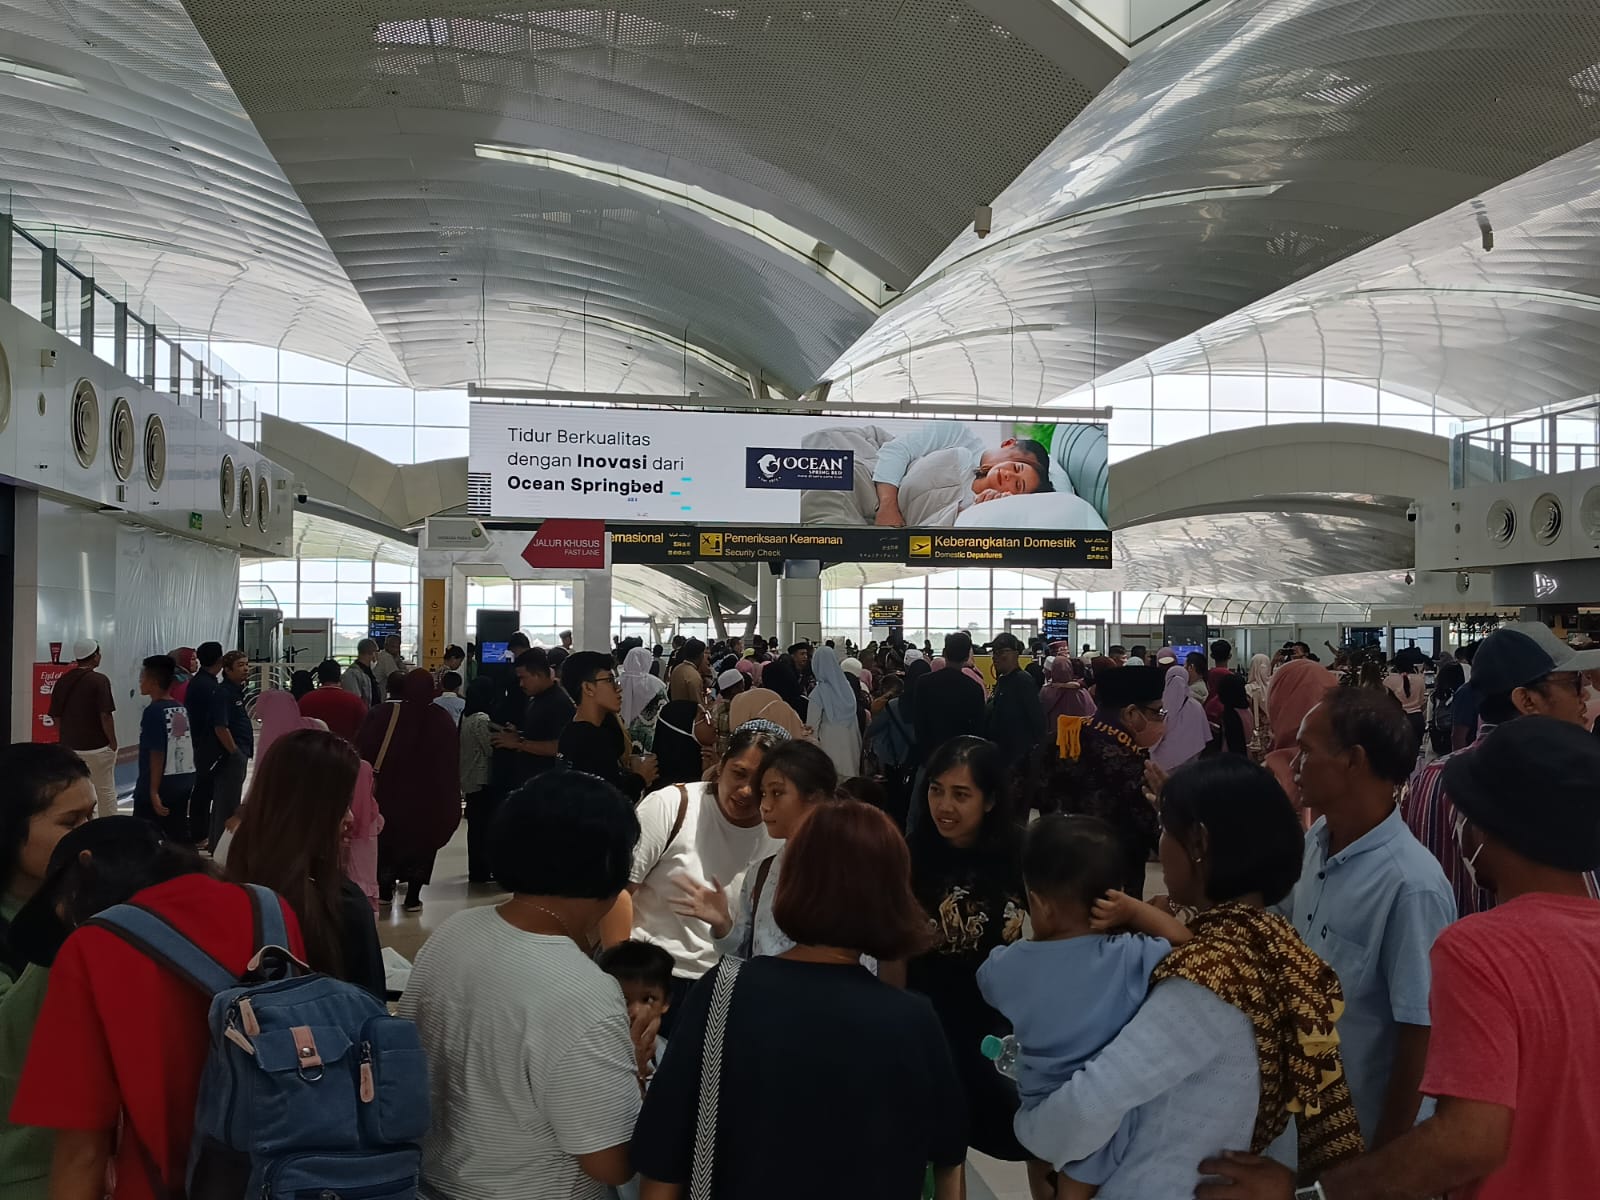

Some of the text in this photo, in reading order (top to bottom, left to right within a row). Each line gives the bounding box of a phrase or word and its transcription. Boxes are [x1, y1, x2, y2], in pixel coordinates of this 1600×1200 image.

[507, 427, 650, 446] Tidur Berkualitas
[507, 452, 684, 471] dengan Inovasi dari
[783, 456, 842, 470] OCEAN
[507, 475, 664, 496] Ocean Springbed
[533, 539, 600, 548] JALUR KHUSUS
[724, 532, 843, 545] Pemeriksaan Keamanan
[934, 536, 1021, 550] Keberangkatan
[1023, 537, 1077, 548] Domestik
[564, 548, 581, 556] FAST
[724, 548, 781, 558] Security Check
[934, 551, 1003, 560] Domestic Departures
